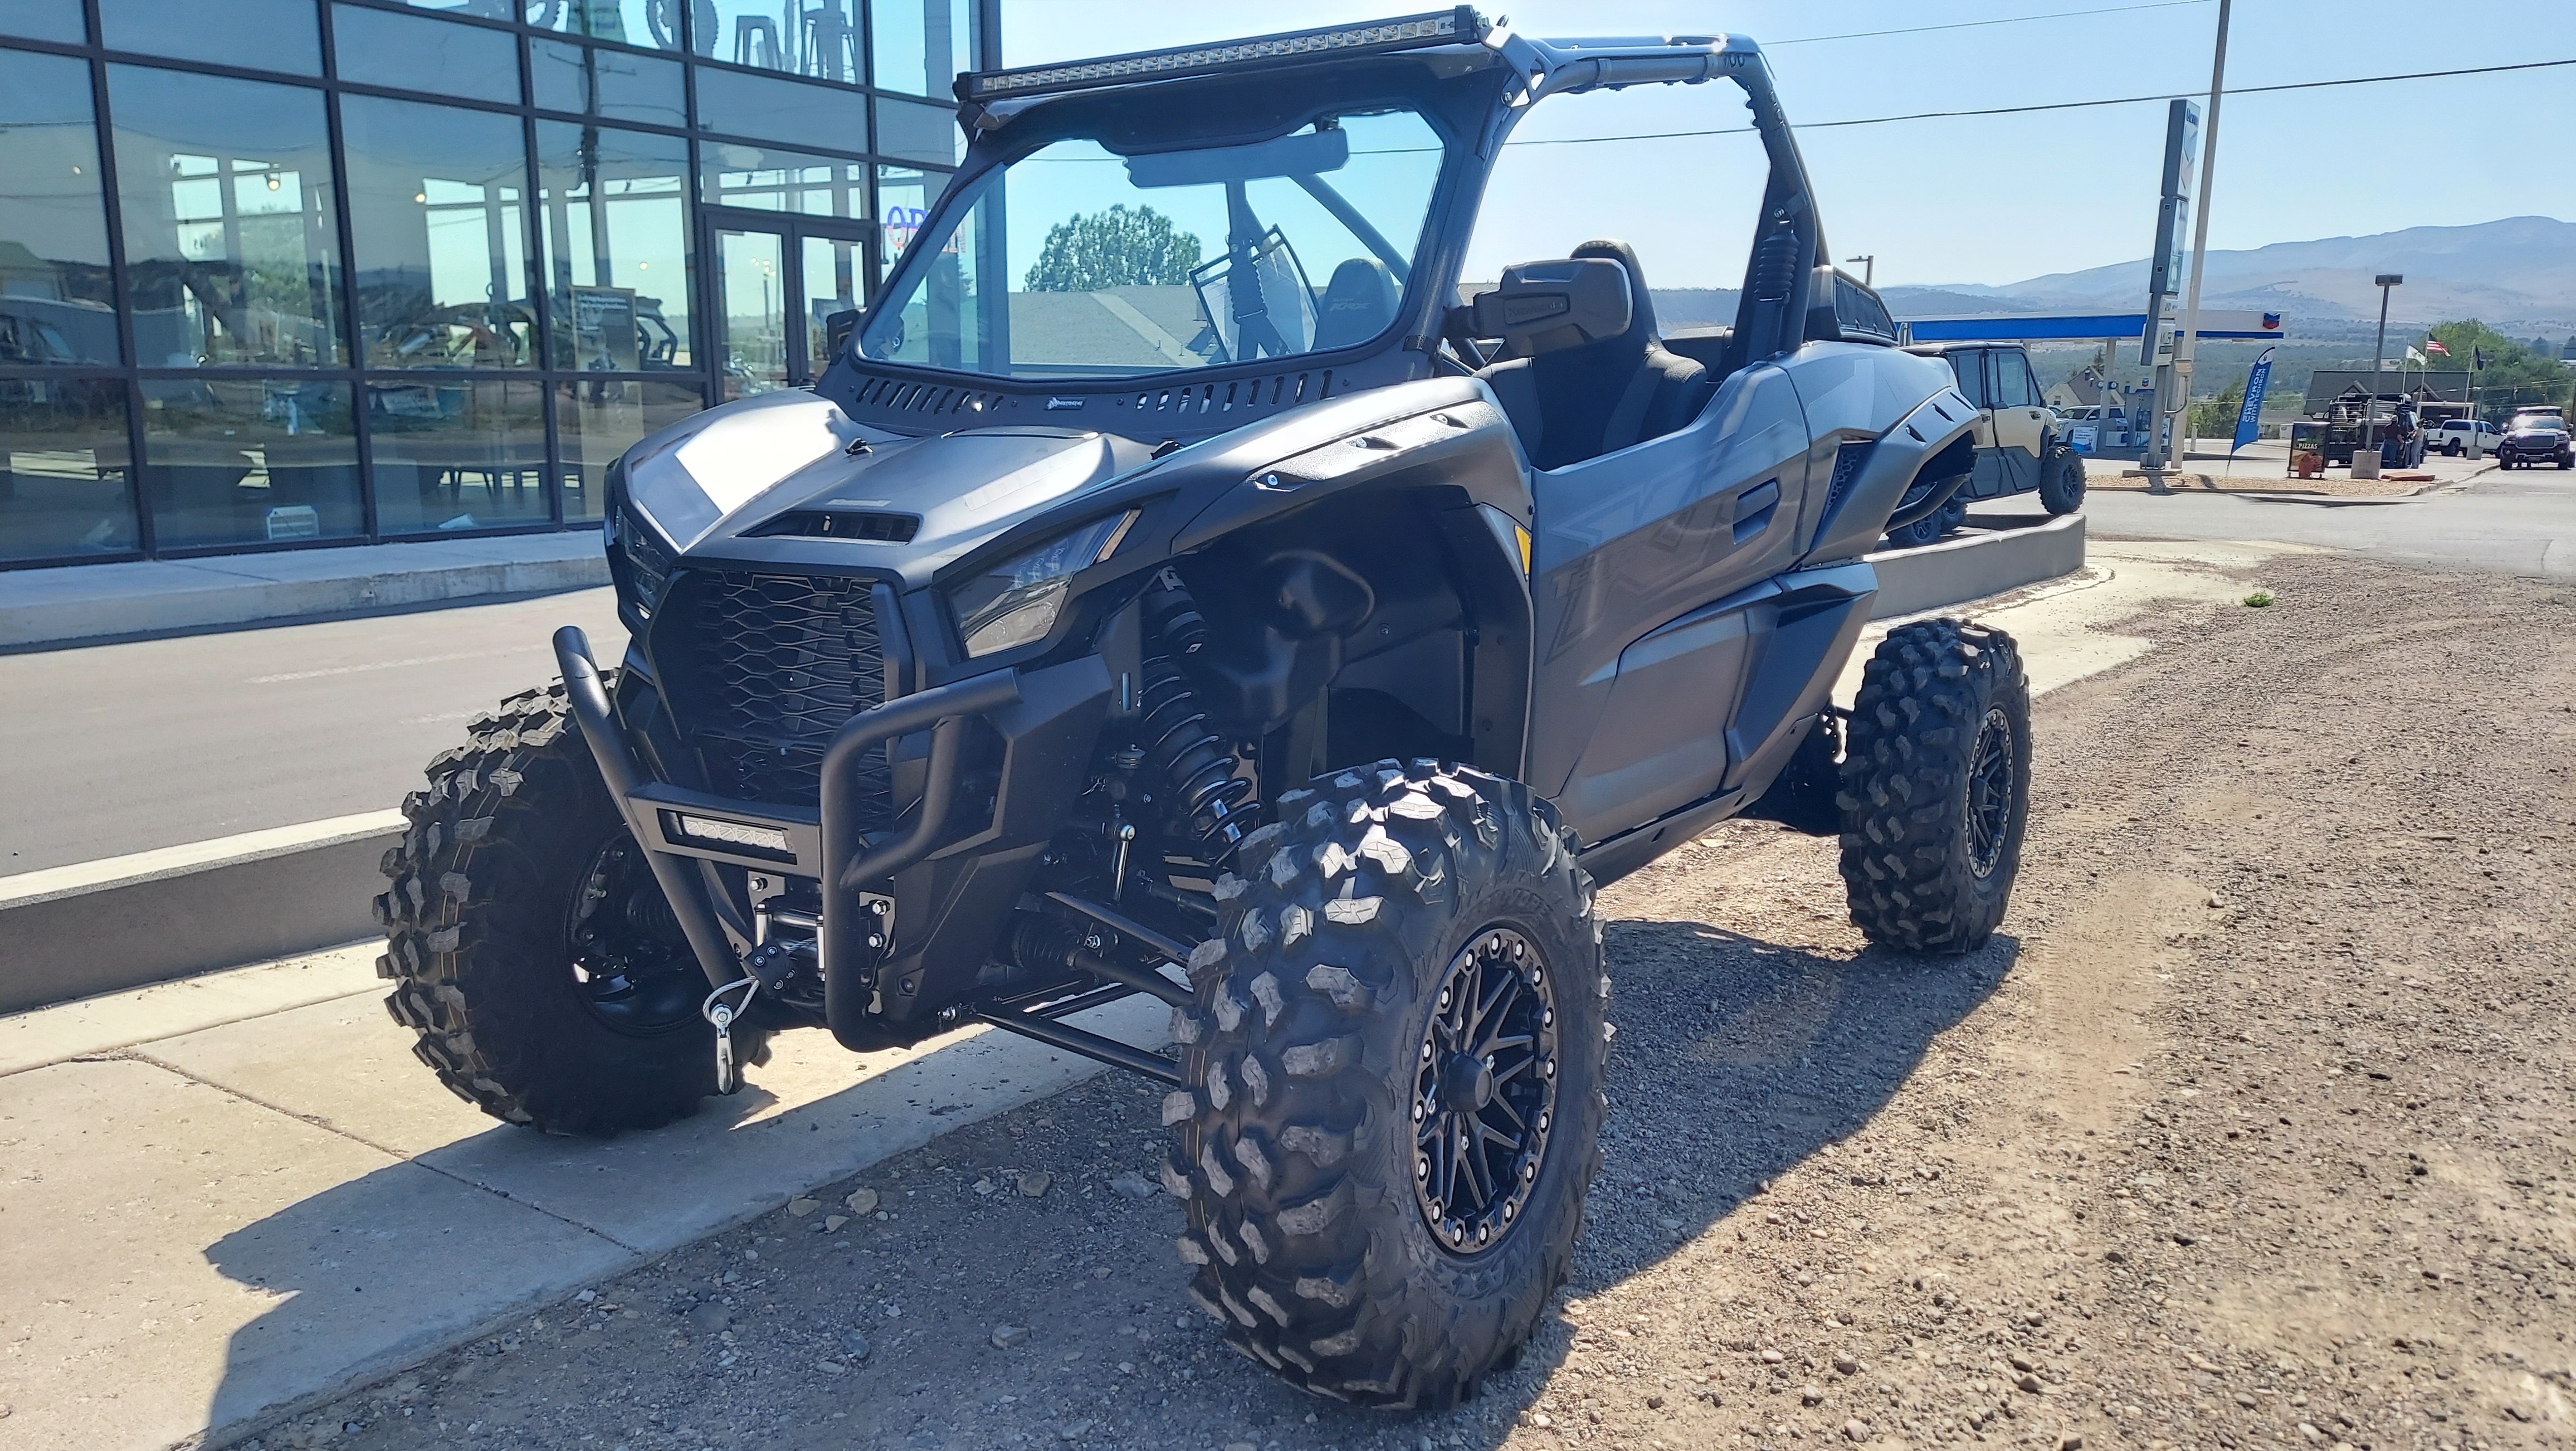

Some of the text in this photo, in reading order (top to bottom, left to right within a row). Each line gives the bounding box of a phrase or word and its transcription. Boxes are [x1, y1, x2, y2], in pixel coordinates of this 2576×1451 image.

[887, 206, 967, 253] OPN
[2243, 368, 2263, 422] CHEVRON
[2255, 368, 2266, 402] TECHRON
